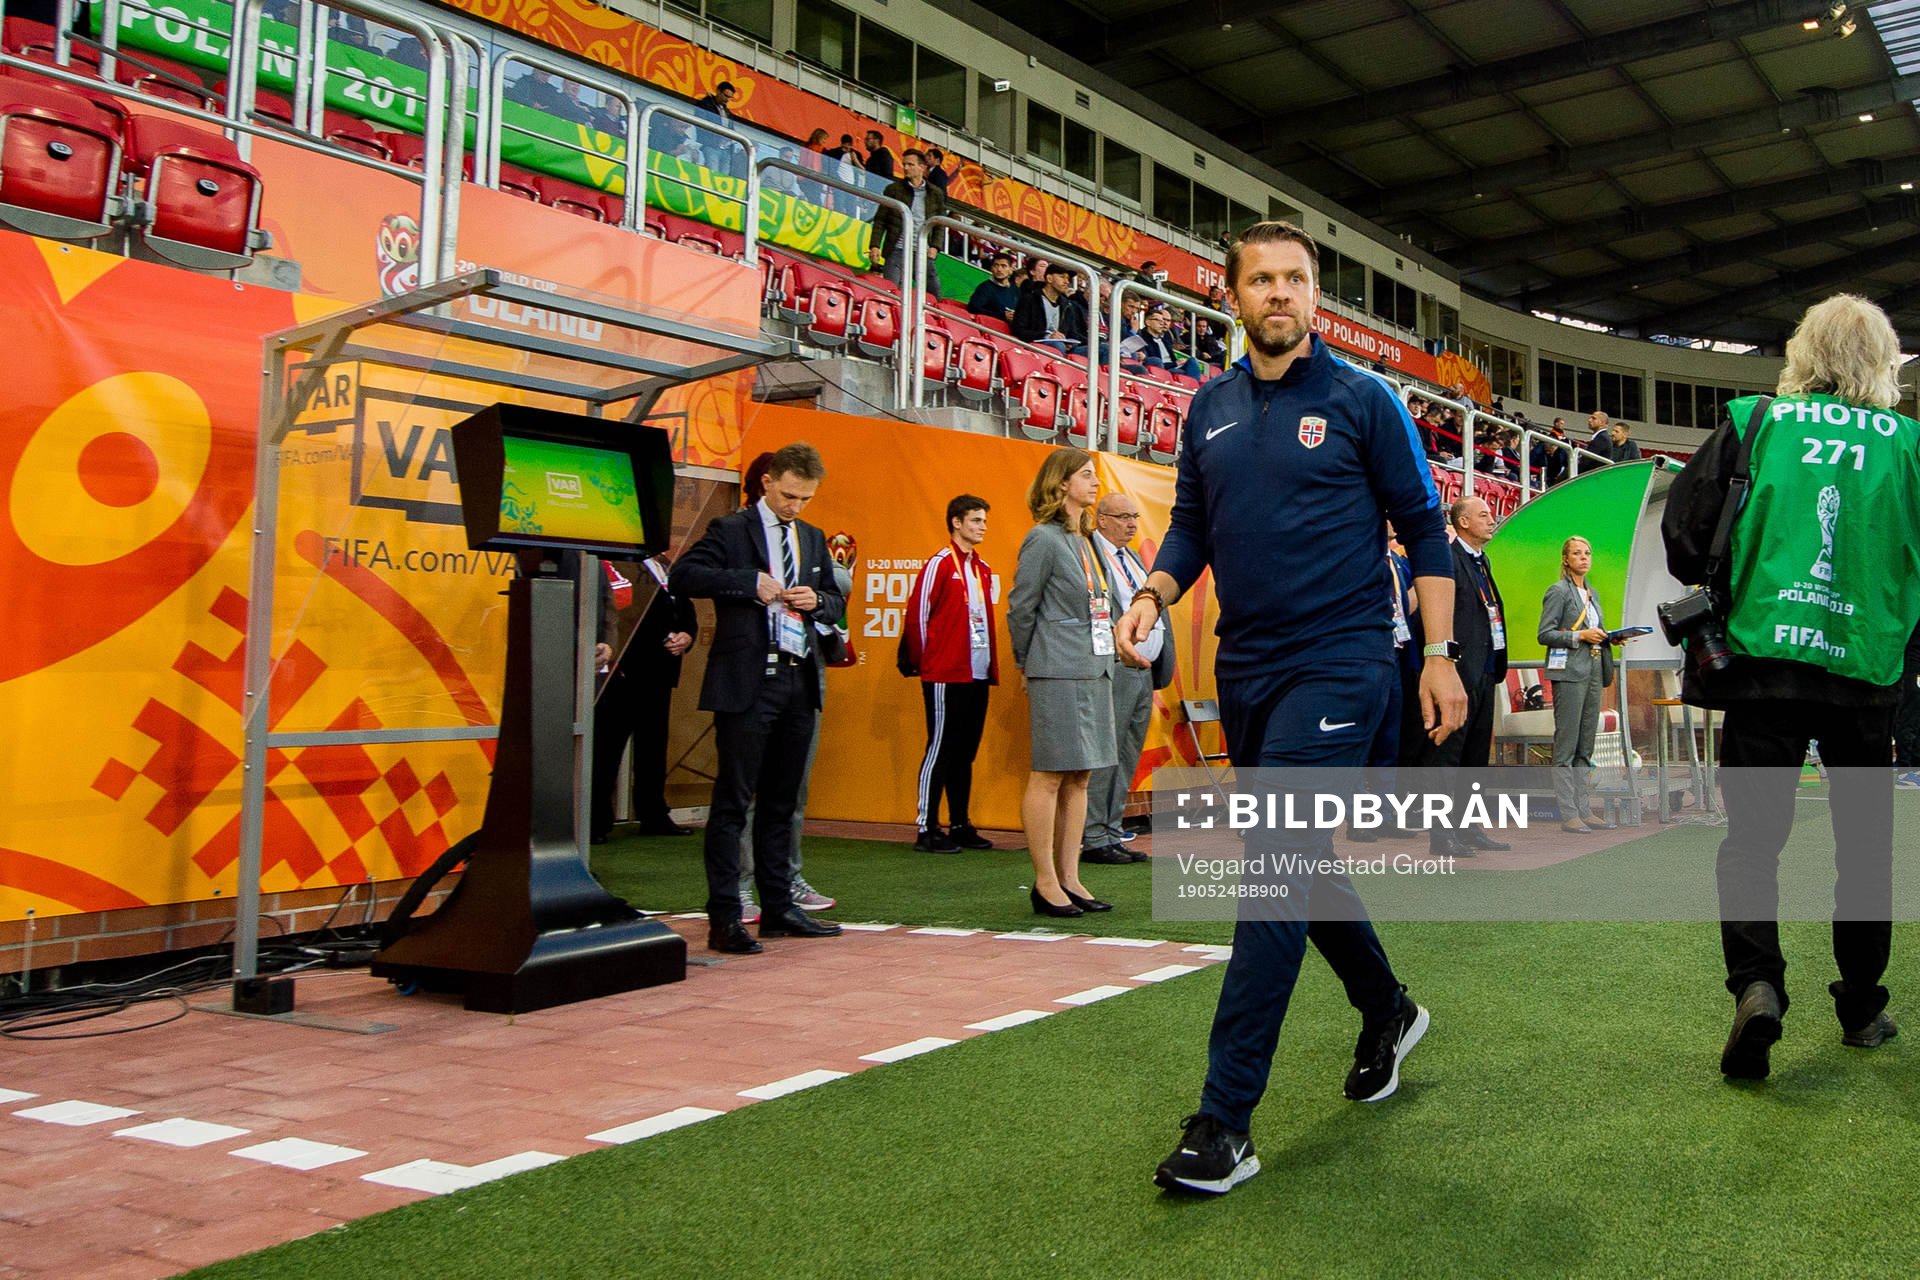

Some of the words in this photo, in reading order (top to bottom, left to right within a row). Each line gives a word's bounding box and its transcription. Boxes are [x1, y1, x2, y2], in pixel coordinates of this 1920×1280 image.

[121, 2, 314, 84] POLN
[343, 67, 418, 117] 201
[455, 259, 476, 273] -20
[468, 294, 604, 342] OLAND
[1197, 265, 1227, 293] FIFA
[1333, 321, 1376, 353] POLAND
[1378, 340, 1401, 363] 2019
[1772, 401, 1898, 437] PHOTO
[377, 420, 459, 484] VA
[1801, 437, 1866, 471] 271
[551, 478, 578, 491] VAR
[323, 536, 516, 577] FIFA.com/VA
[866, 559, 890, 570] U-20
[893, 559, 928, 570] WORL
[1777, 589, 1830, 608] POLAN
[1829, 600, 1854, 616] 019
[1793, 581, 1813, 590] U-20
[863, 607, 908, 638] 20
